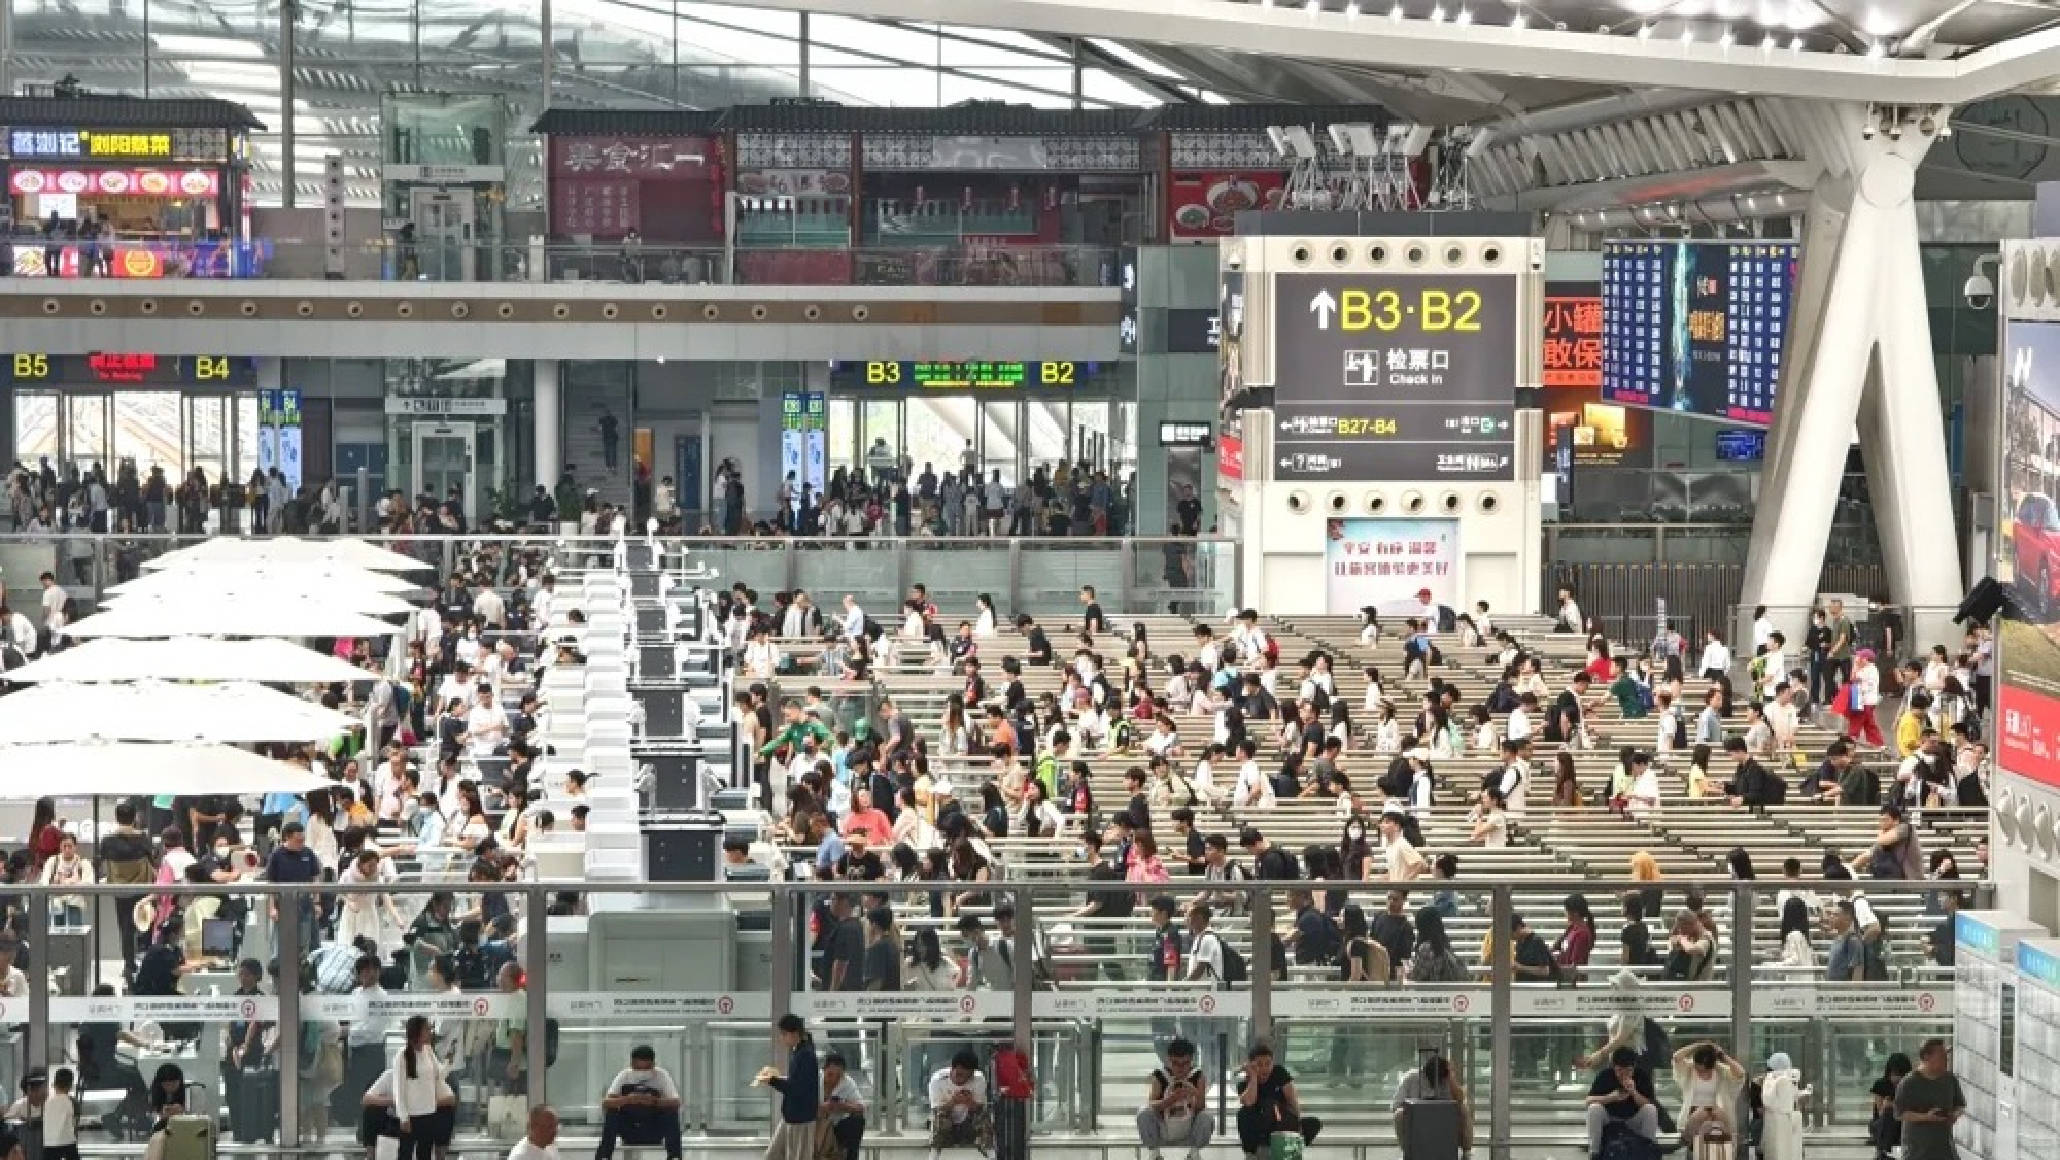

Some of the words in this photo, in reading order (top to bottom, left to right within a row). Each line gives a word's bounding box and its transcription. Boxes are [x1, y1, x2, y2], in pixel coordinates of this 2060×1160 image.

[14, 353, 47, 377] B5
[196, 356, 229, 379] B4
[1386, 348, 1449, 371] 检票口
[867, 361, 900, 383] B3
[1041, 362, 1073, 383] B2
[1338, 418, 1397, 435] B27-B4
